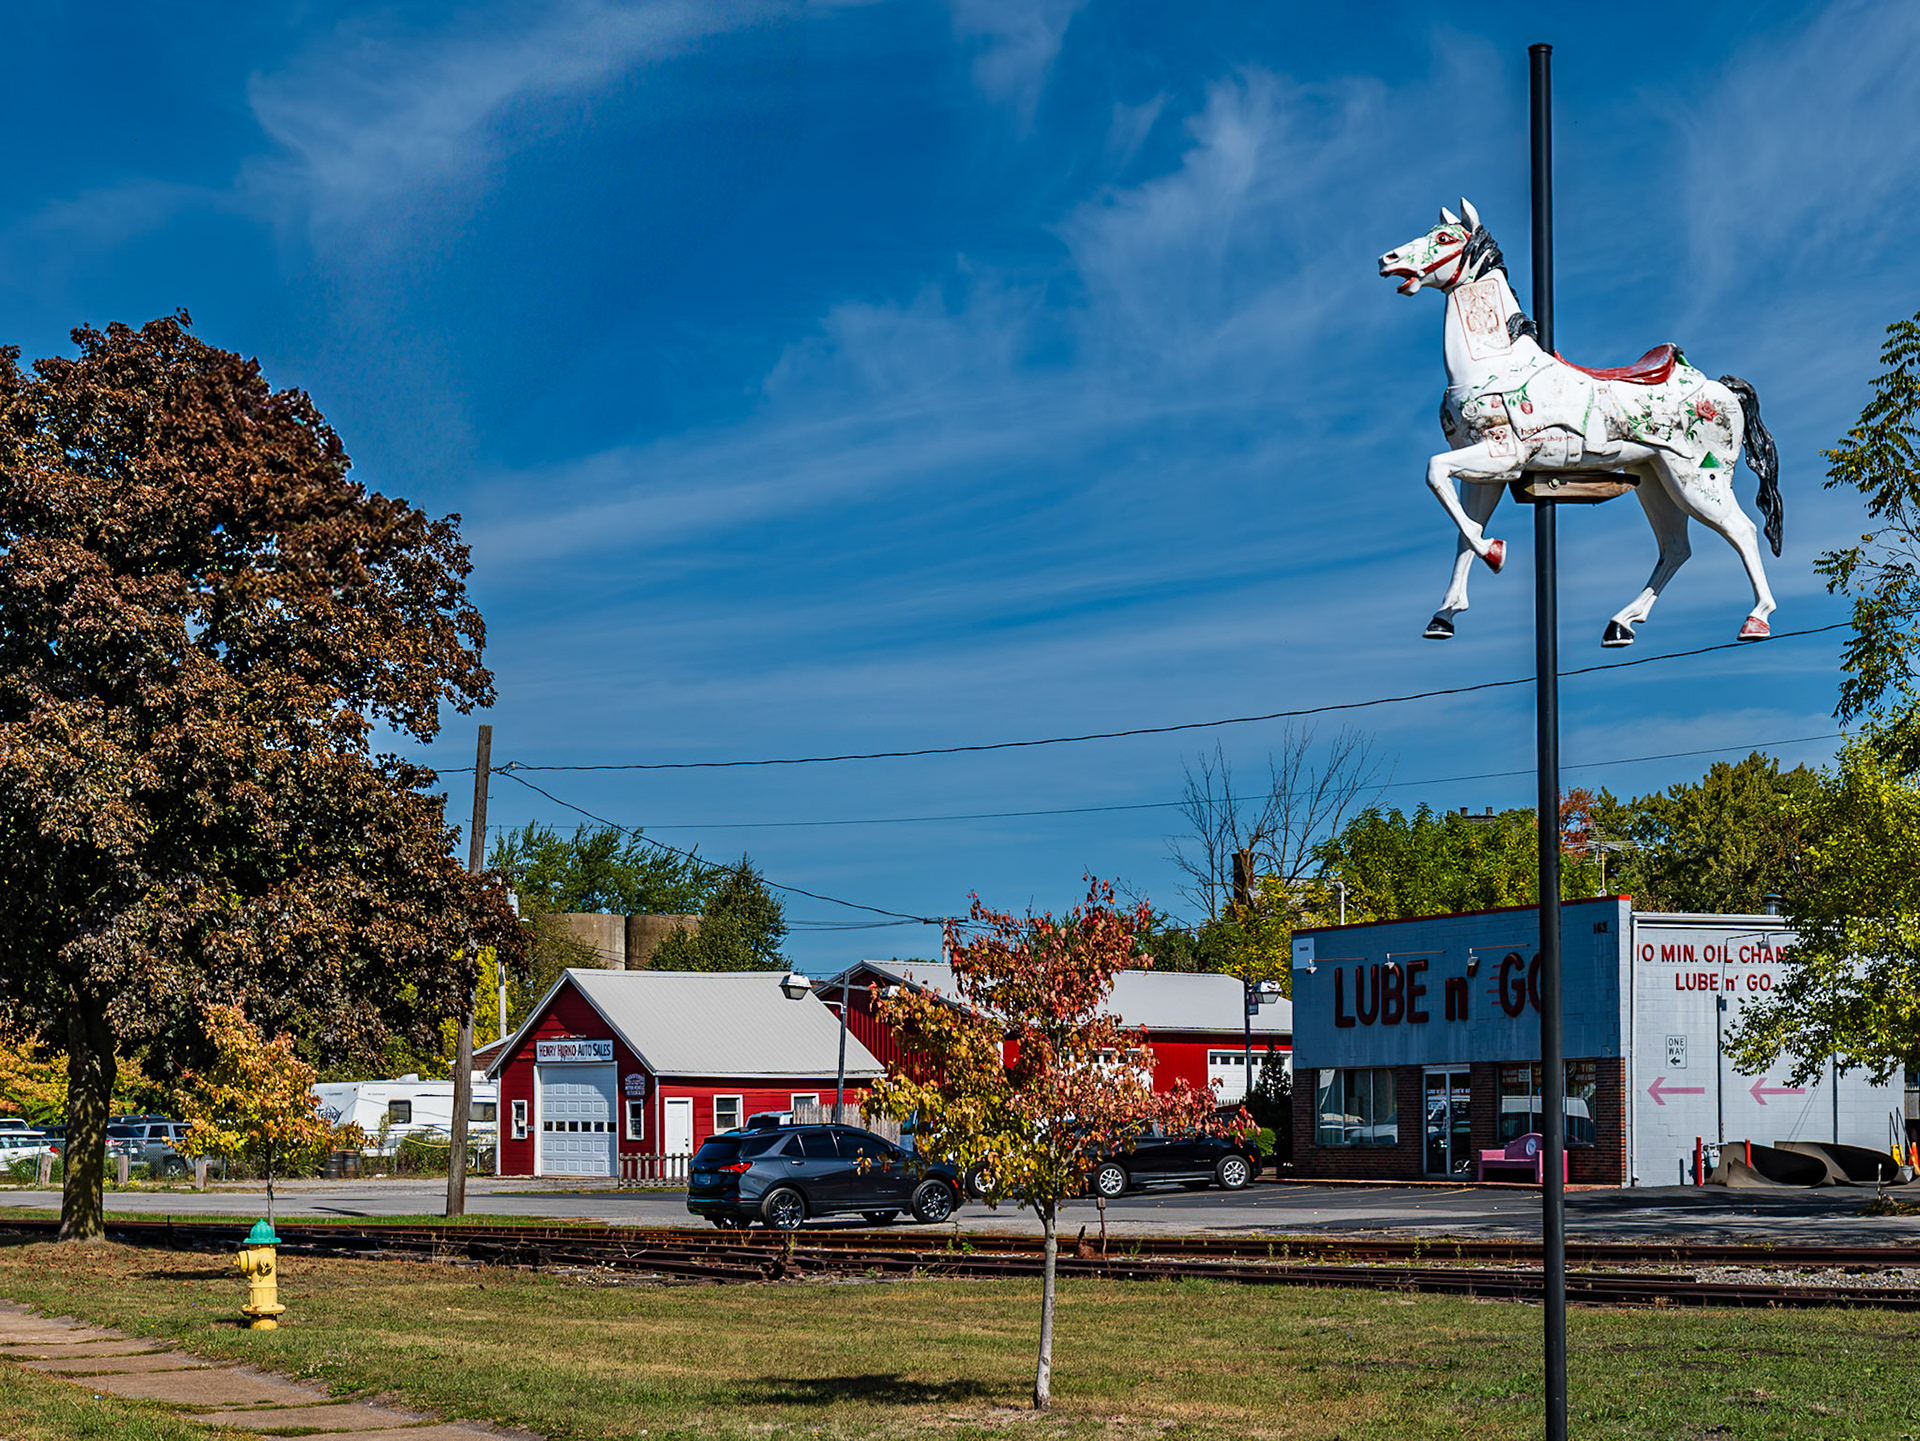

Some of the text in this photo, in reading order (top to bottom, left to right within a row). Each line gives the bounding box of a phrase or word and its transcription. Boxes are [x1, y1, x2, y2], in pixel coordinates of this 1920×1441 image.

[1661, 944, 1699, 963] MIN.
[1703, 944, 1734, 964] OIL
[1675, 972, 1772, 991] LUBE n' GO
[1334, 958, 1430, 1028] LUBE
[539, 1045, 557, 1057] HENRY
[578, 1043, 592, 1057] AUTO
[592, 1043, 611, 1057] SALES
[1668, 1037, 1685, 1047] ONE
[1668, 1047, 1685, 1055] WAY
